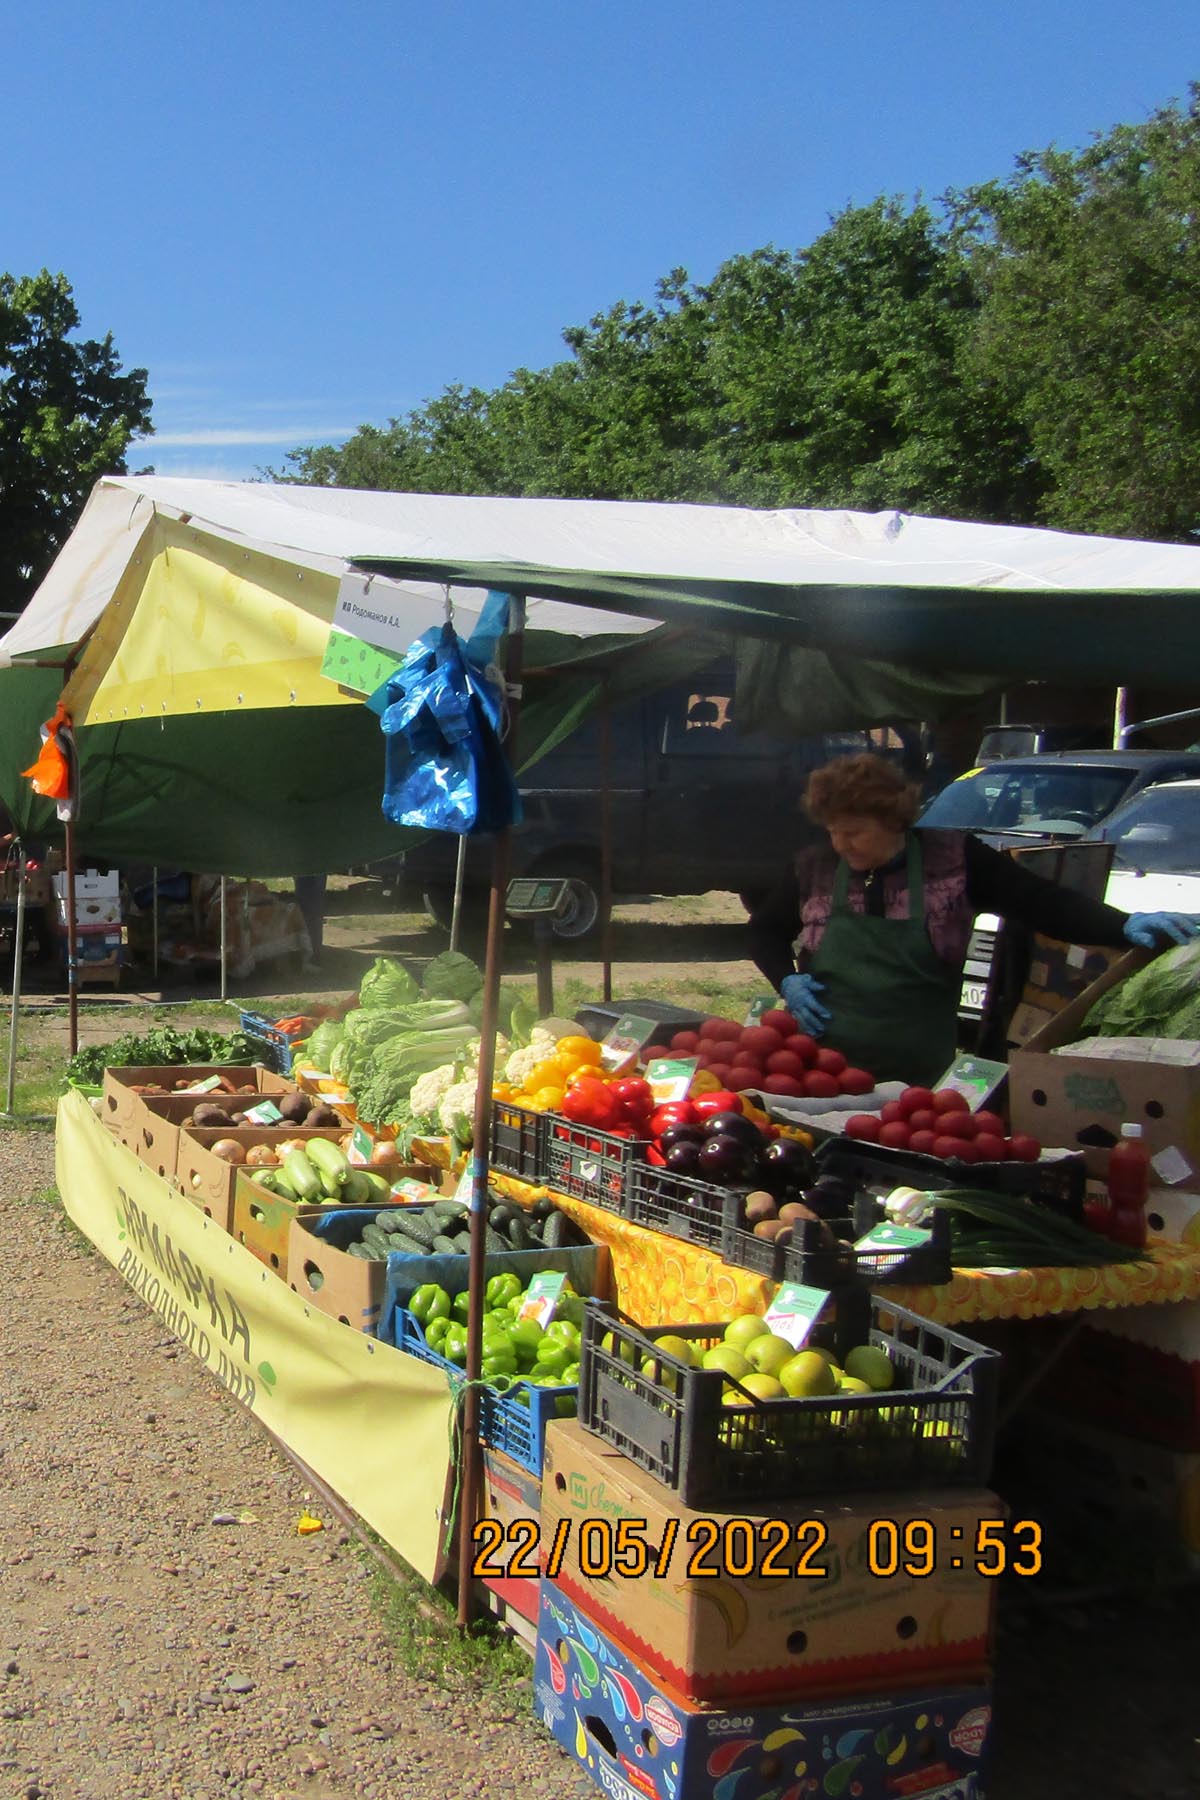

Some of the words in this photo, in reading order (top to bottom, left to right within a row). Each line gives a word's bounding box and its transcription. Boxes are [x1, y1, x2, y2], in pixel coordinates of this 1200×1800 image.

[118, 1186, 250, 1362] ЯРМАРКА
[118, 1247, 210, 1362] ВЫХОДНОГО
[217, 1350, 256, 1407] ДНЯ
[648, 1710, 679, 1734] ECUADOR
